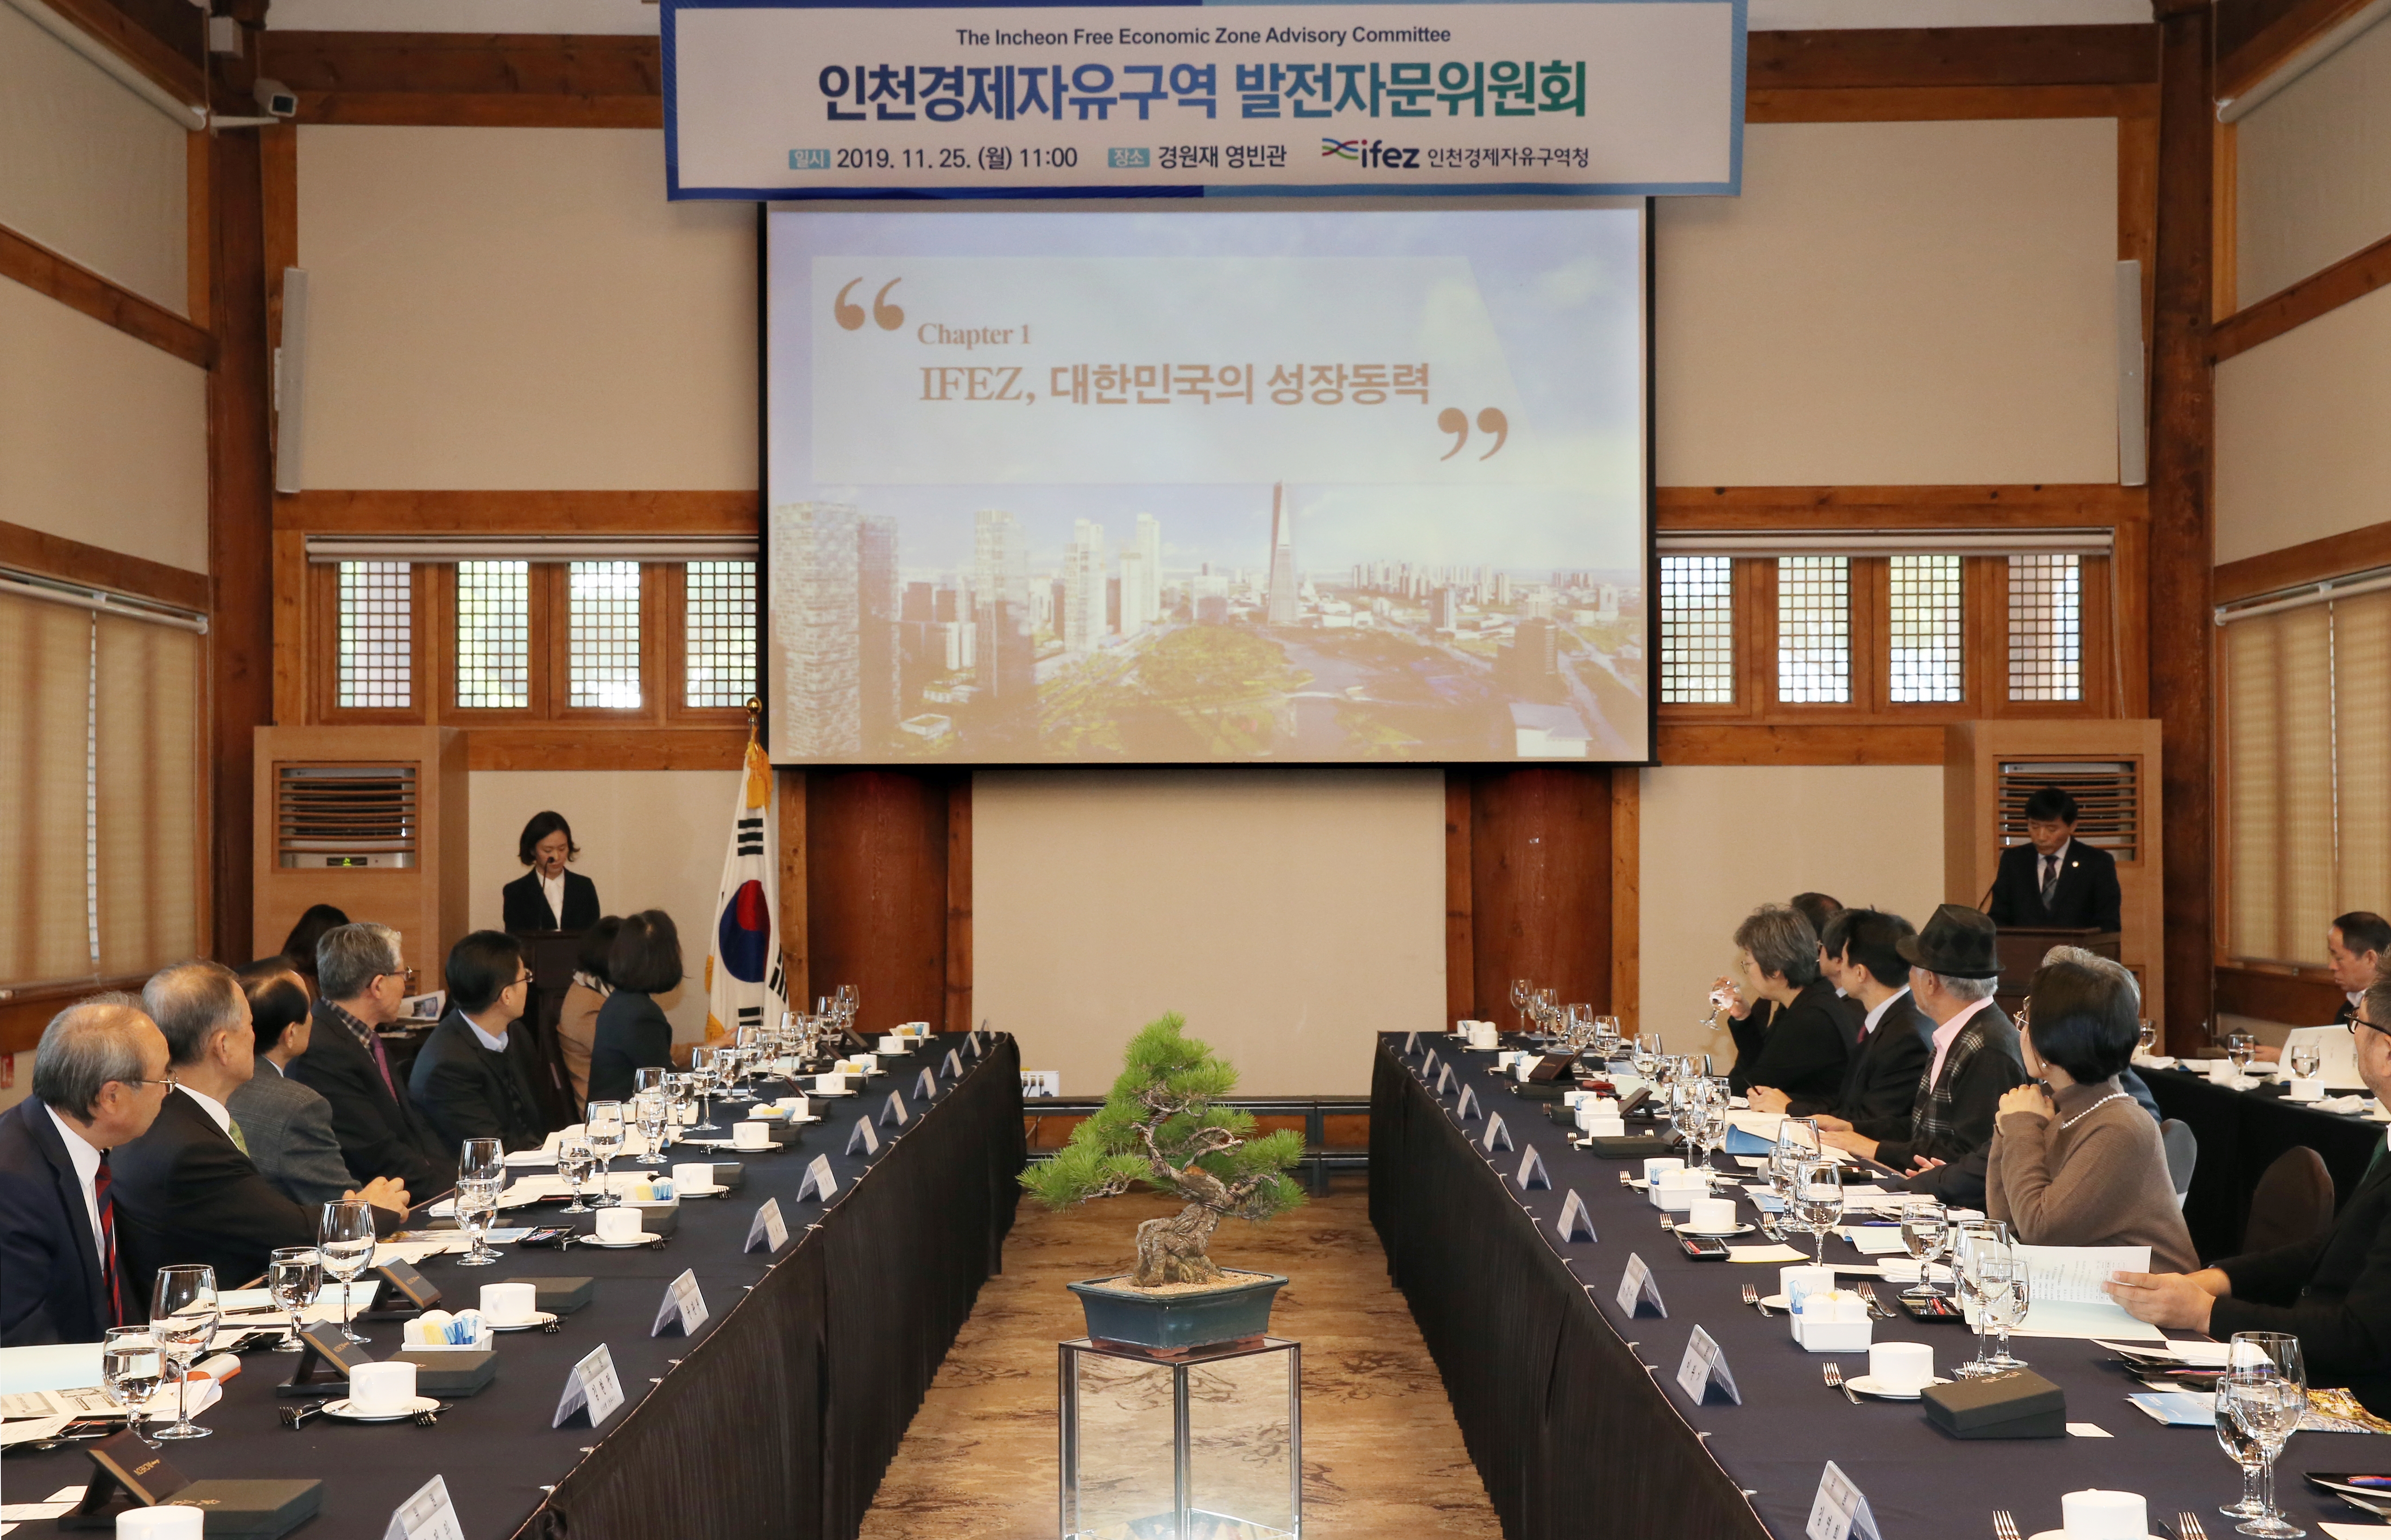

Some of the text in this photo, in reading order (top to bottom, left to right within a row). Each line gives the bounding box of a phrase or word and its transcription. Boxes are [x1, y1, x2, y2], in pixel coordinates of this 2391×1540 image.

[956, 26, 1451, 47] The Incheon Free Economic Zone Advisory Committee
[818, 59, 1586, 123] 인천경제자유구역 발전자문위원회
[794, 146, 1078, 170] 일시 2019. 11. 25. (월) 11:00
[1114, 145, 1287, 169] 장소 경원재 영빈관
[1362, 139, 1420, 169] ifez
[1427, 147, 1589, 169] 인천경제자유구역청
[917, 323, 1031, 350] Chapter 1
[919, 363, 1429, 406] IFEZ, 대한민국의 성장동력
